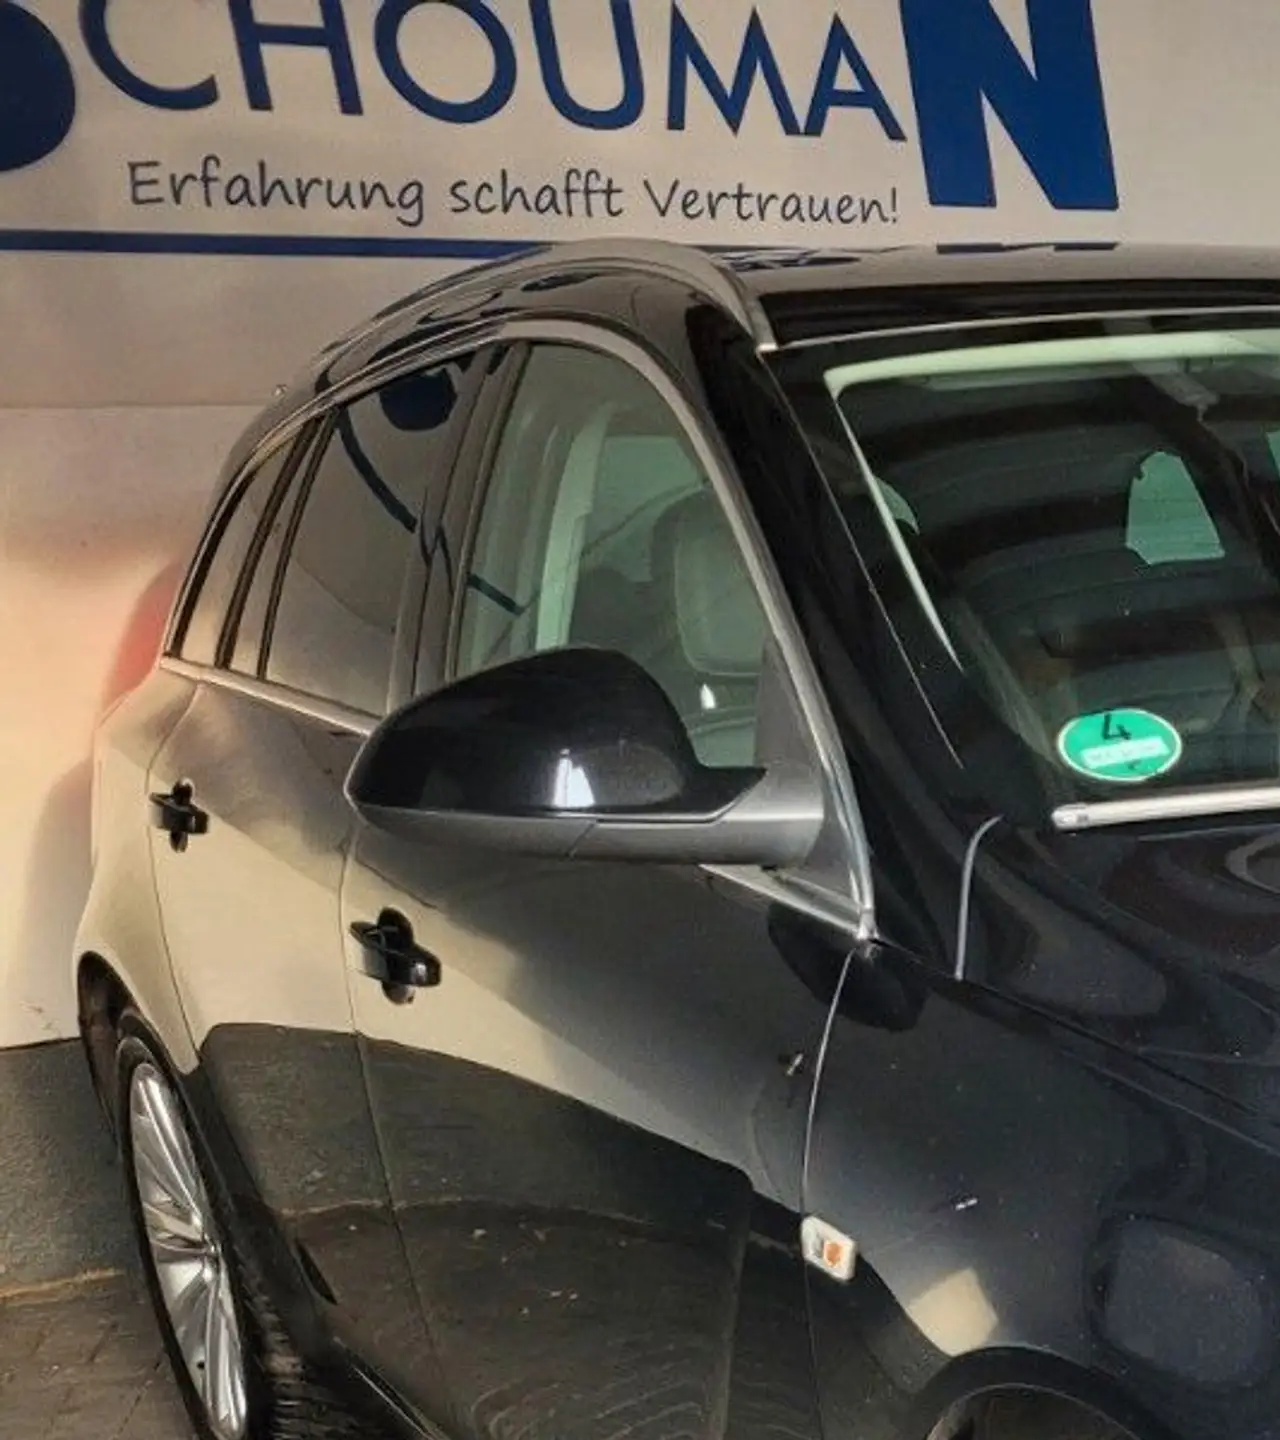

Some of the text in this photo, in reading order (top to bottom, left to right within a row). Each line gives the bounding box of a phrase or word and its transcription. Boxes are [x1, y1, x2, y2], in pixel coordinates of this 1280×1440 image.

[128, 154, 898, 227] Erfahrung schafft Vertrauen!
[1102, 713, 1132, 740] 4
